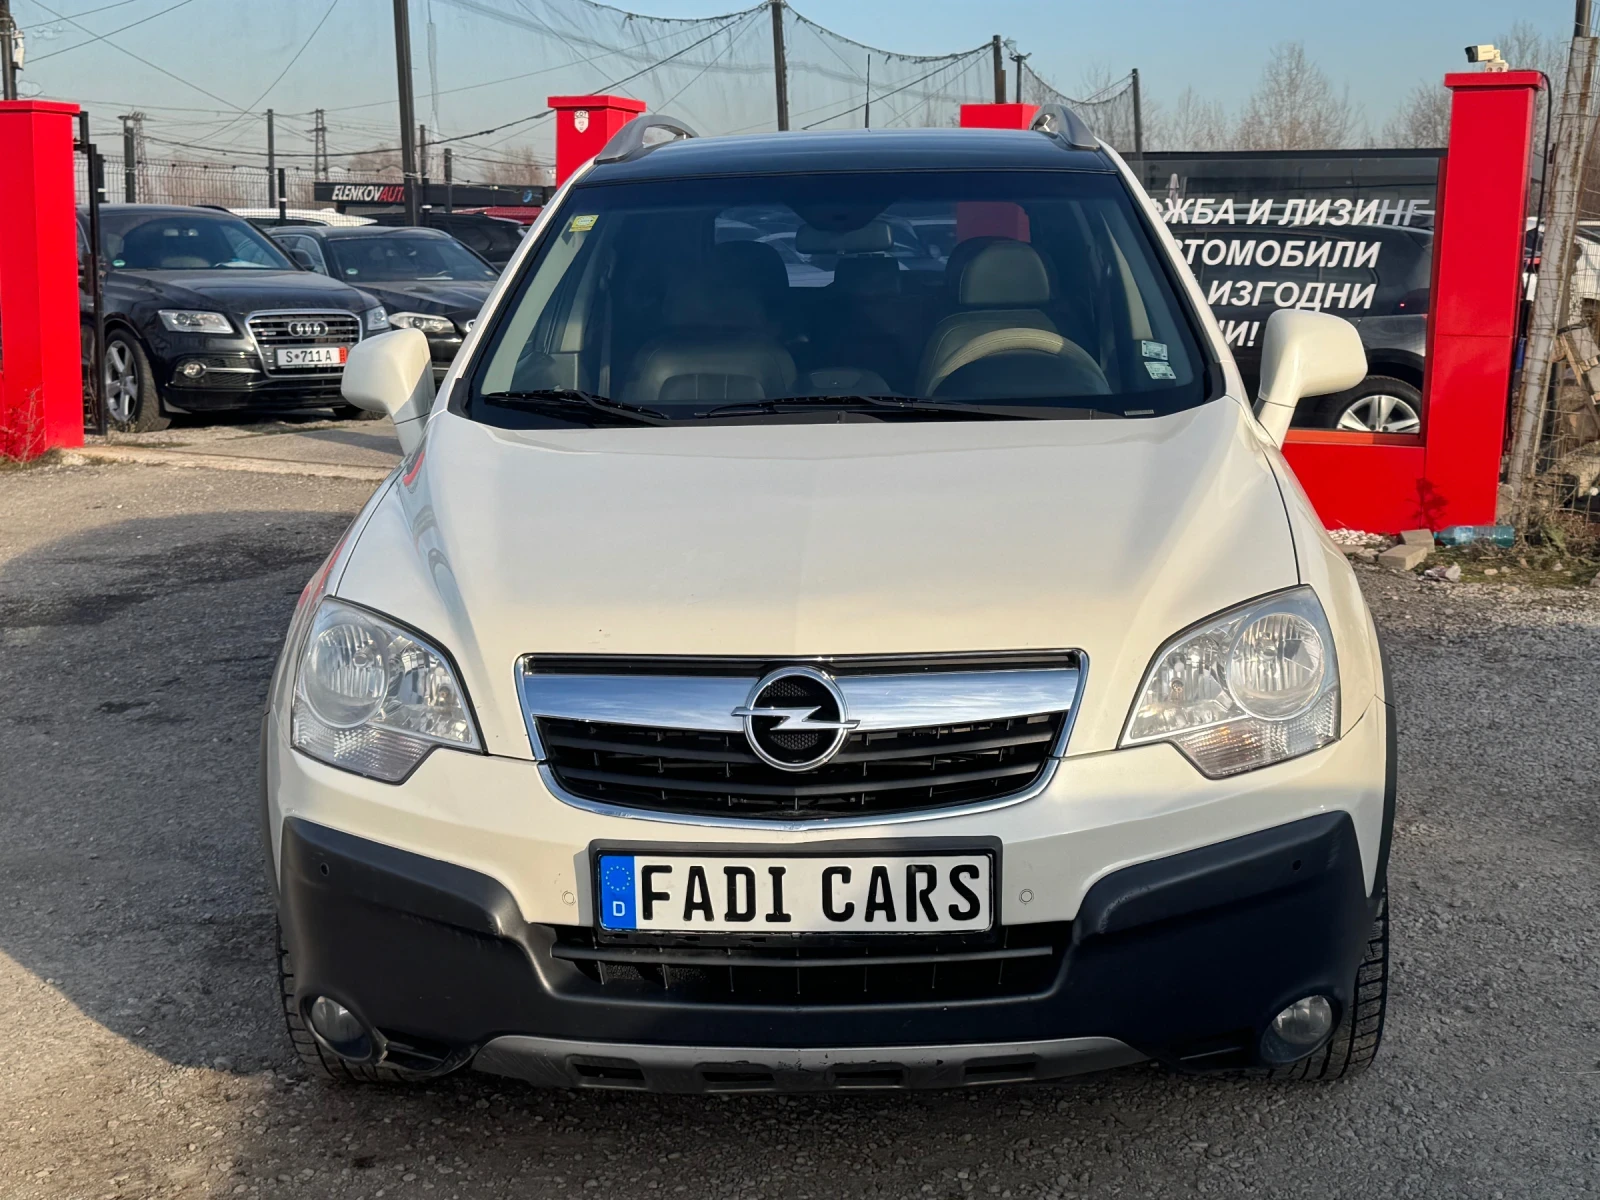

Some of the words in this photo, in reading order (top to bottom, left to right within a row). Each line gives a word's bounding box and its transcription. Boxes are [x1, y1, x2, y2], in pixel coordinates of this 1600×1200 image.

[331, 184, 406, 202] ELENKOVAUT
[1246, 199, 1274, 225] И
[1278, 199, 1430, 226] ЛИЗИНГ
[1207, 280, 1377, 312] ИЗГОДНИ
[1218, 320, 1260, 347] И!
[641, 865, 791, 922] FADI
[822, 864, 981, 922] CARS
[613, 901, 625, 916] D
